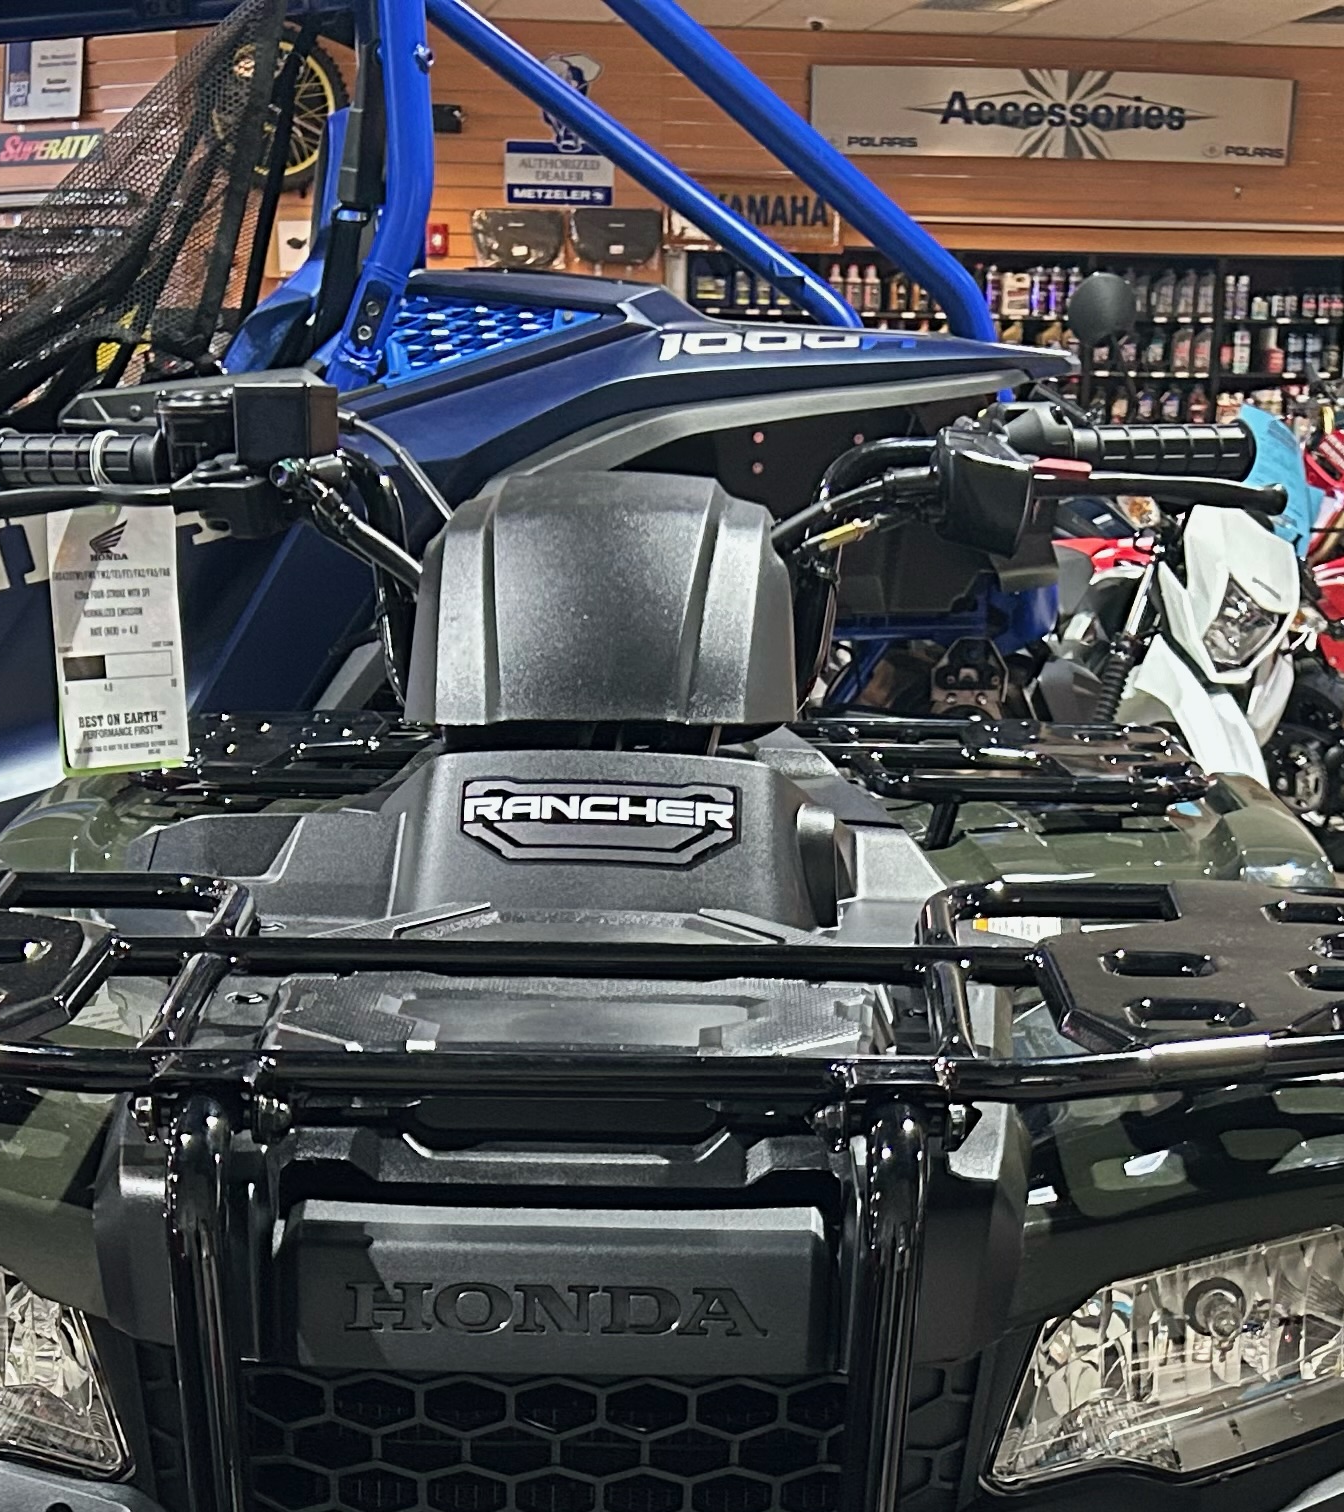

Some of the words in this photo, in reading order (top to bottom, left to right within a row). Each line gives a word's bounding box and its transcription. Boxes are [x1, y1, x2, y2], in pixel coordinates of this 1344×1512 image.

[939, 89, 1187, 132] Accessories
[847, 135, 918, 149] POLARIS
[1223, 144, 1285, 159] POLARIS
[518, 157, 602, 171] AUTHORIZED
[534, 170, 584, 182] DEALER
[512, 188, 591, 201] METZELER
[719, 193, 829, 227] AMAHA
[89, 552, 129, 562] HONDA
[78, 714, 104, 729] BEST
[107, 713, 120, 726] ON
[82, 728, 133, 741] PERFORMANCE
[463, 795, 734, 830] RANCHER
[344, 1282, 769, 1338] HONDA
